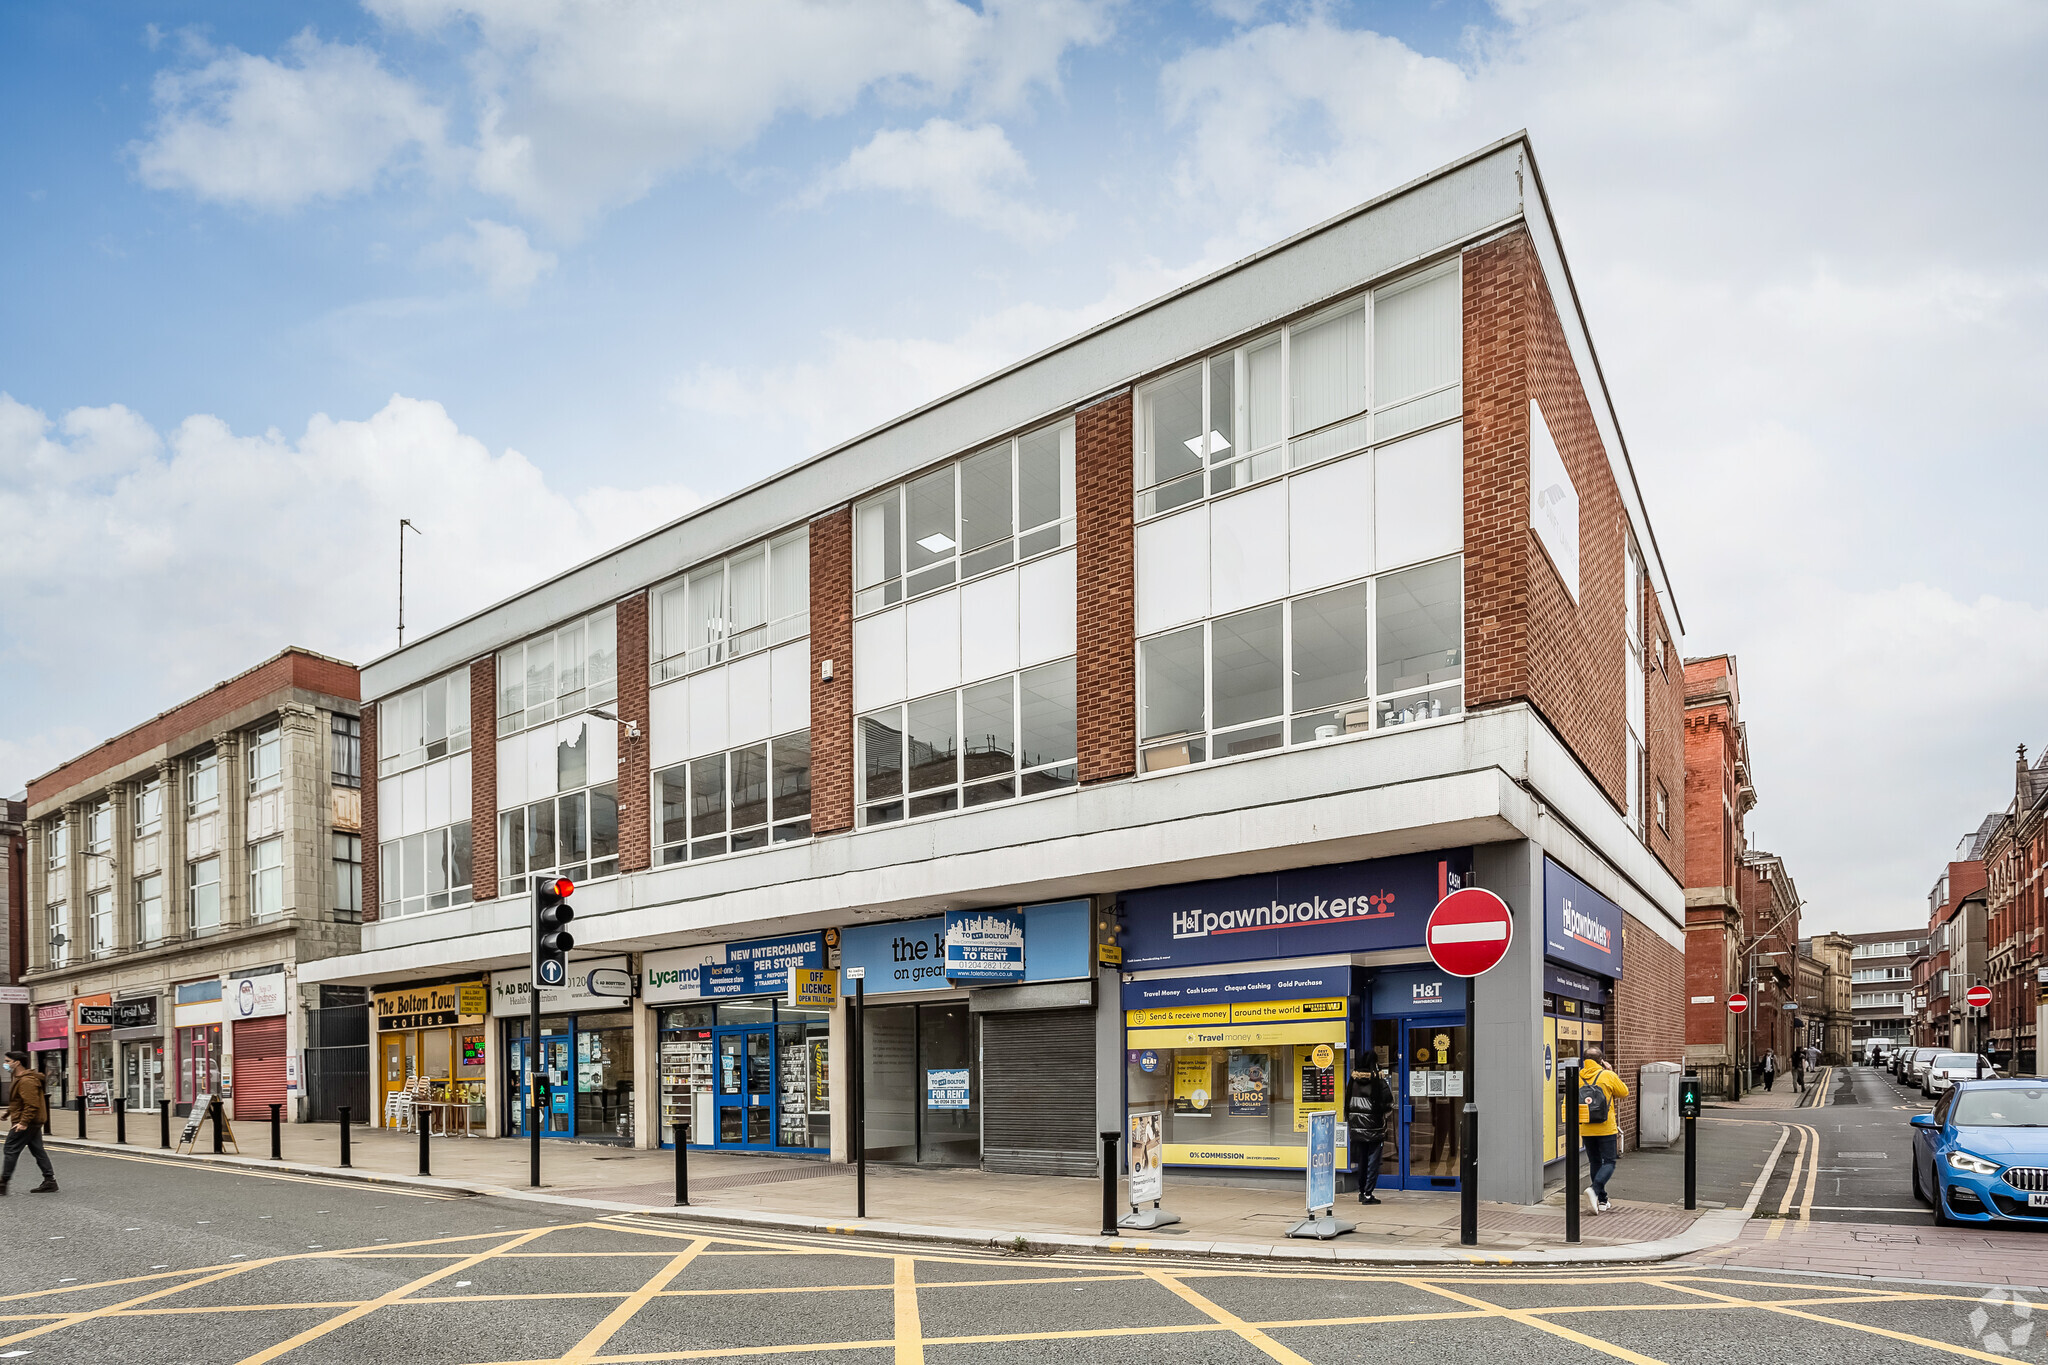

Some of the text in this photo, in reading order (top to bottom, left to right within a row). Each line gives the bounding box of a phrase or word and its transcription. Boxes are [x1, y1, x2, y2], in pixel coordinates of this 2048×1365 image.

[1448, 871, 1461, 888] CASH
[1173, 895, 1369, 936] H&T pawnbrokers
[1571, 909, 1607, 947] pawnbrokers
[730, 941, 817, 961] NEW INTERCHANGE
[892, 937, 929, 962] the
[962, 952, 1008, 960] TO RENT
[754, 956, 804, 971] PER STORE
[959, 961, 982, 969] 01204
[711, 967, 734, 975] best-one
[894, 968, 909, 980] on
[709, 977, 733, 985] Convenience
[733, 976, 745, 984] store
[809, 972, 824, 982] OFF
[758, 979, 781, 987] TRANSFER
[1144, 978, 1323, 998] Travel Money Cash Loans Cheque Cashing Gold Purchase
[505, 984, 516, 996] AD
[713, 985, 741, 993] NOW OPEN
[801, 983, 832, 994] LICENCE
[1412, 982, 1443, 998] H&T
[377, 998, 394, 1016] The
[397, 994, 429, 1014] Bolton
[510, 996, 527, 1005] Health
[822, 996, 835, 1004] 11pm
[81, 1008, 112, 1018] Crystal
[1149, 1010, 1227, 1020] Send & receive money
[1235, 1006, 1300, 1016] around the world
[392, 1015, 443, 1028] coffee
[1197, 1033, 1224, 1042] Travel
[1225, 1033, 1252, 1042] money
[815, 1047, 823, 1101] Lucozade
[932, 1089, 965, 1099] FOR RENT
[1233, 1093, 1264, 1101] EUROS
[1200, 1152, 1244, 1160] COMMISSION
[1312, 1151, 1332, 1168] GOLD
